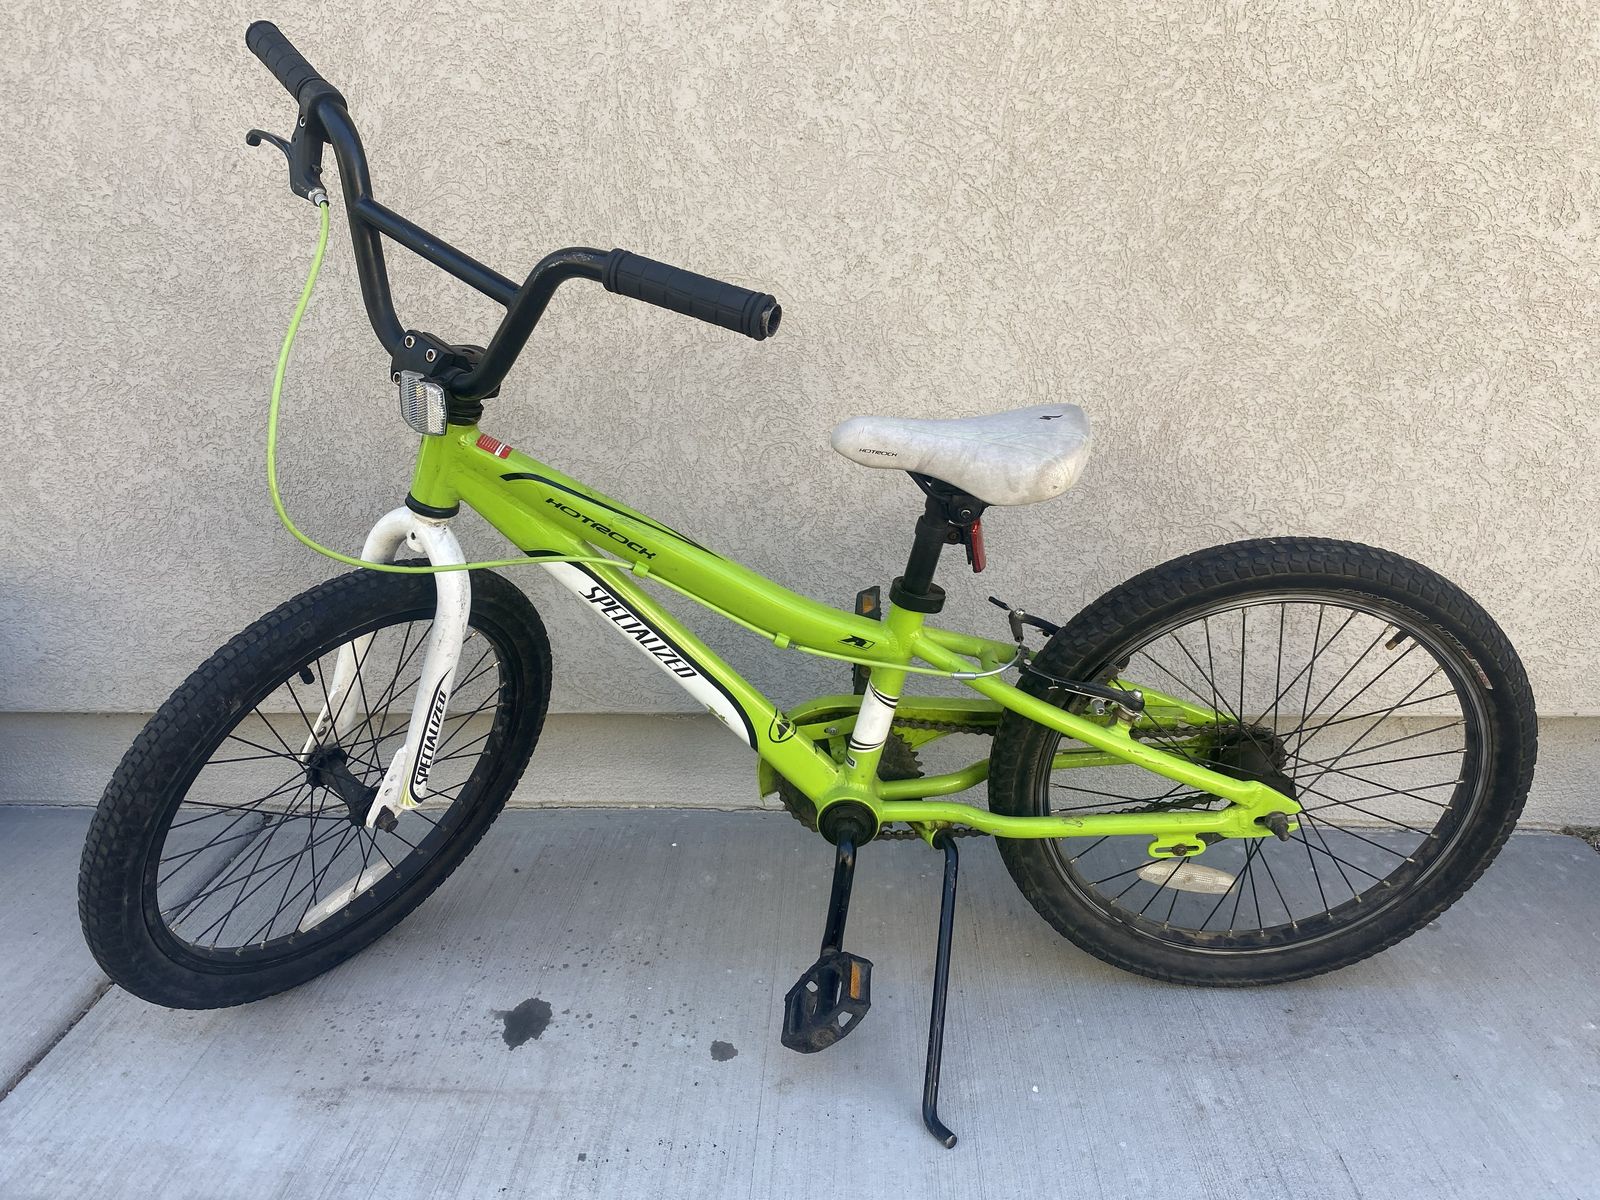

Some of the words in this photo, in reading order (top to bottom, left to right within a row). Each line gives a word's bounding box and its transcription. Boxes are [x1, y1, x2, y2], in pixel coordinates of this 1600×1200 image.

[545, 497, 657, 560] HOTROCK
[578, 586, 698, 678] SPECIALIZED
[414, 689, 447, 787] SPECIALIZED
